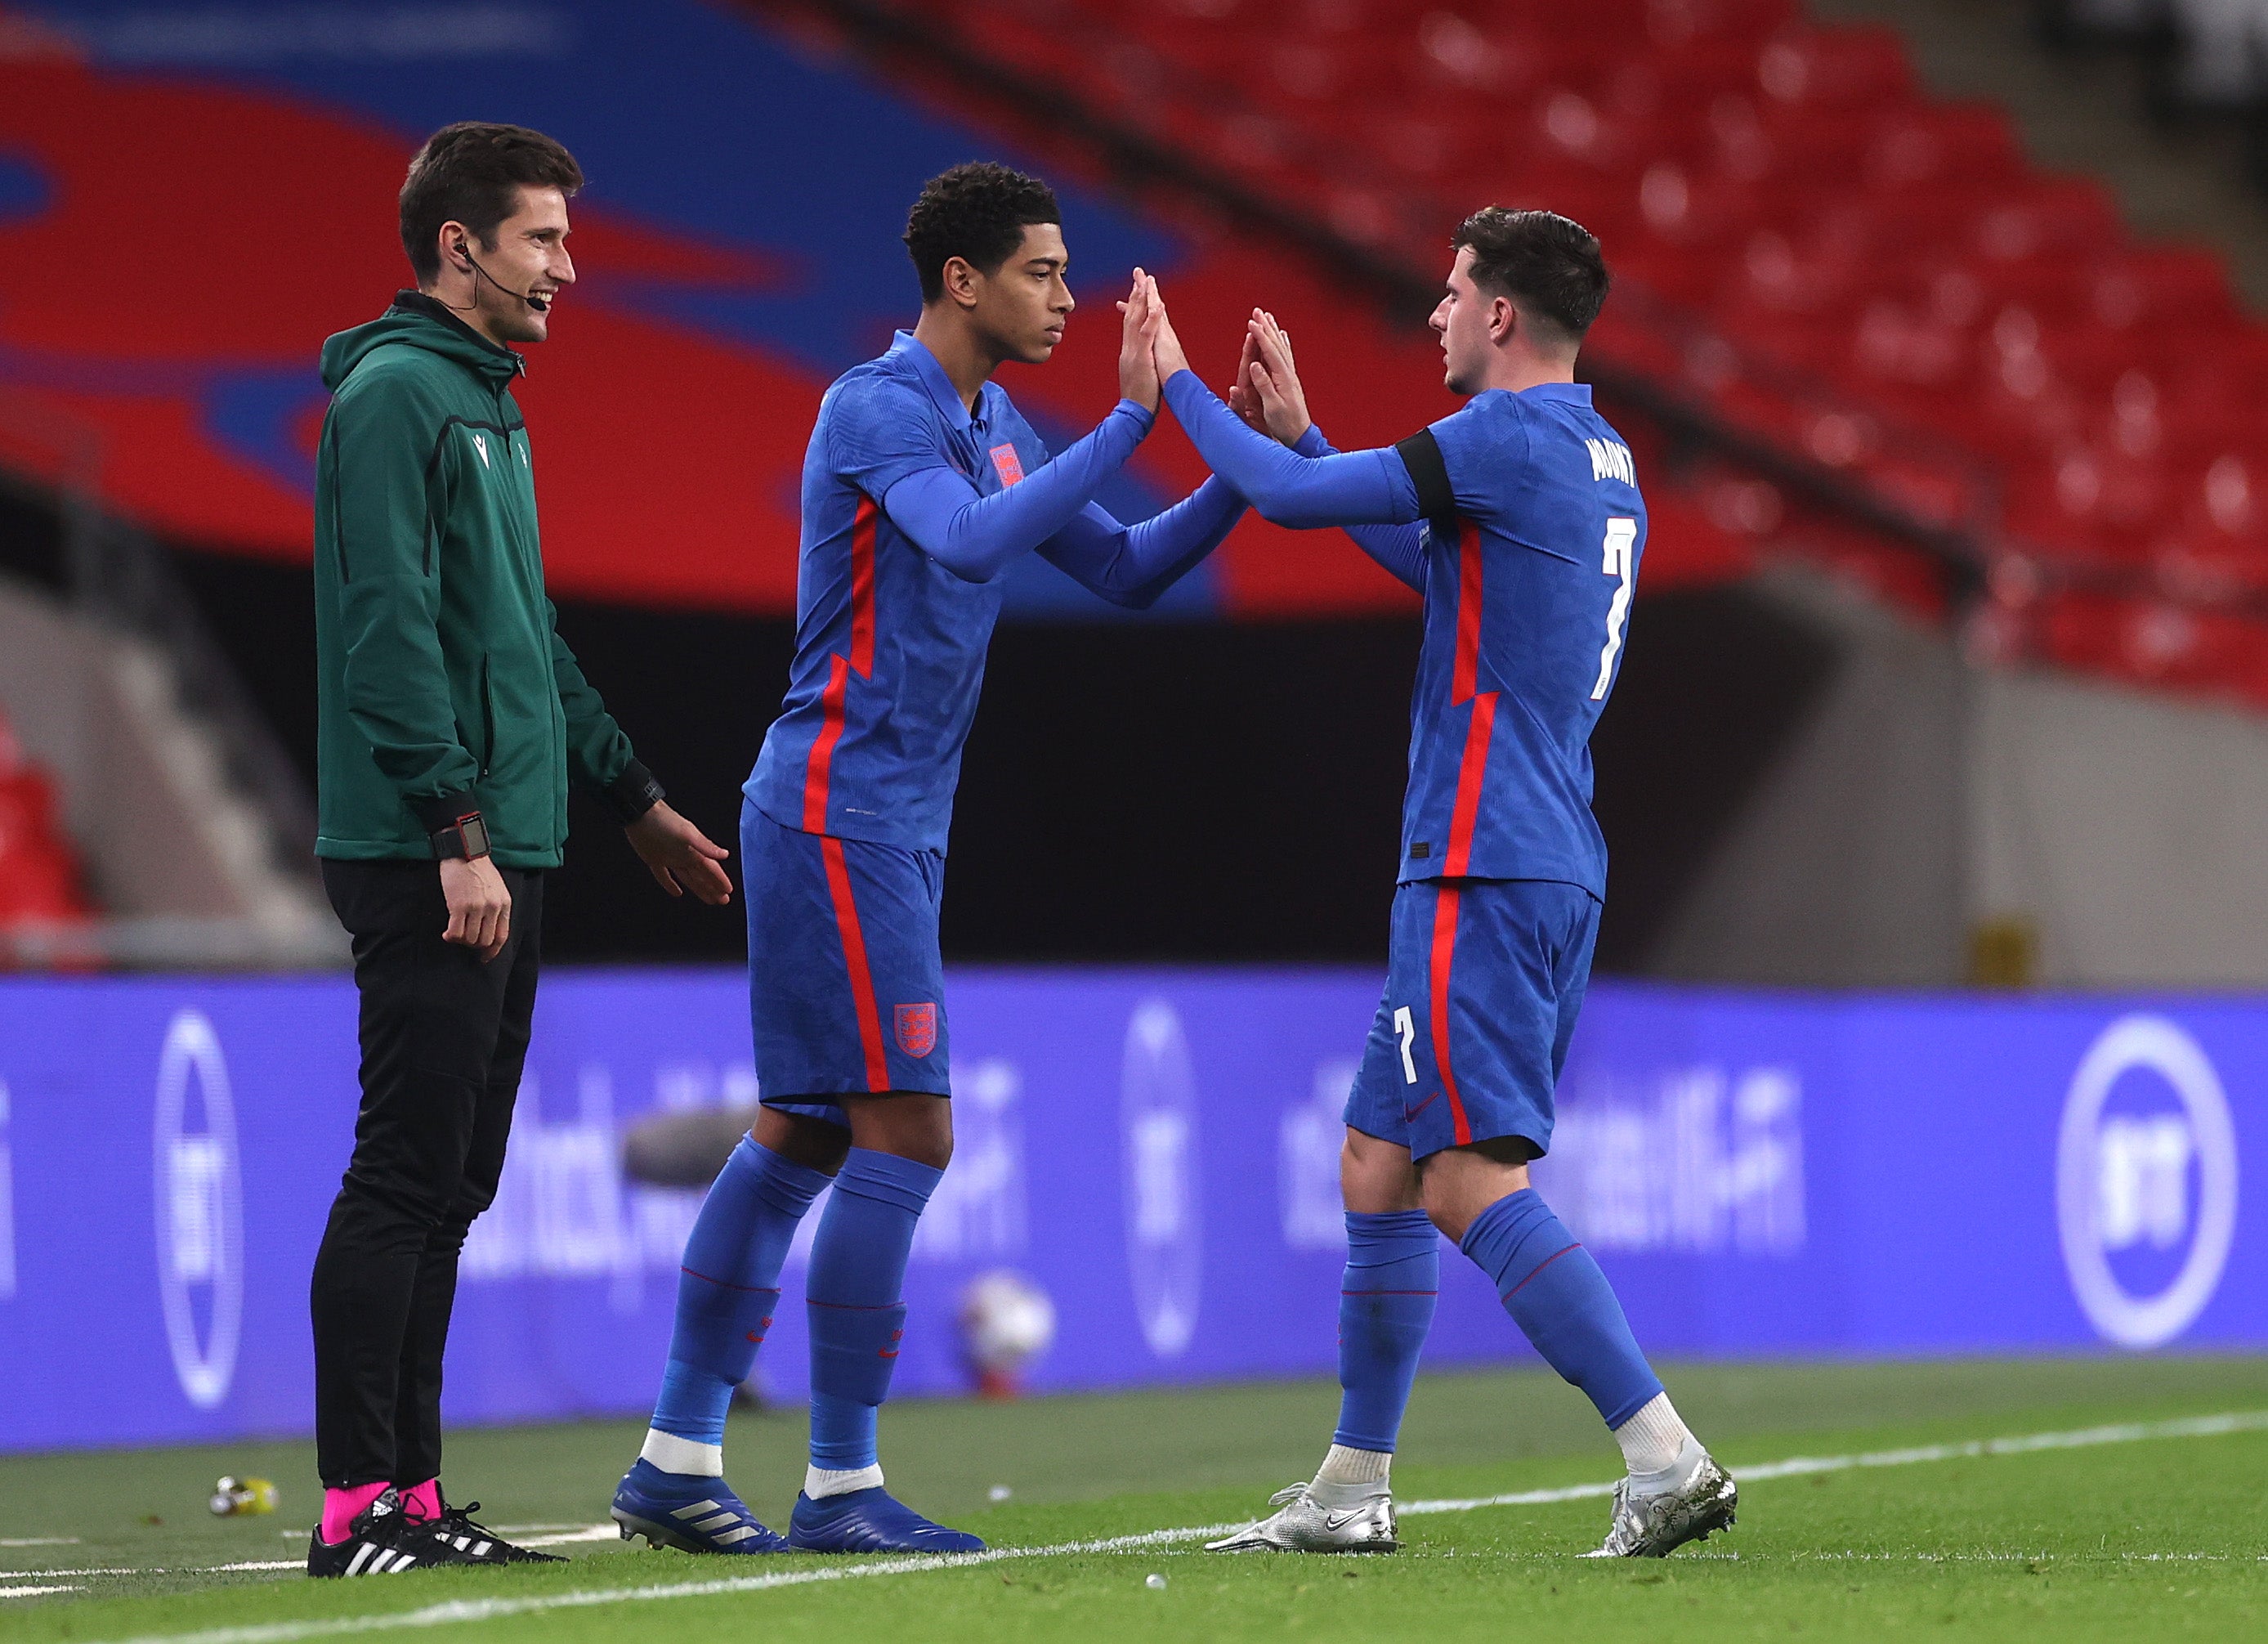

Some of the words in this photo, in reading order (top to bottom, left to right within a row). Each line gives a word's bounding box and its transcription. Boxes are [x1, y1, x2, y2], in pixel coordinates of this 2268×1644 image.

[1585, 437, 1635, 489] MOUNT
[1590, 517, 1637, 700] 7
[1393, 1006, 1417, 1085] 7
